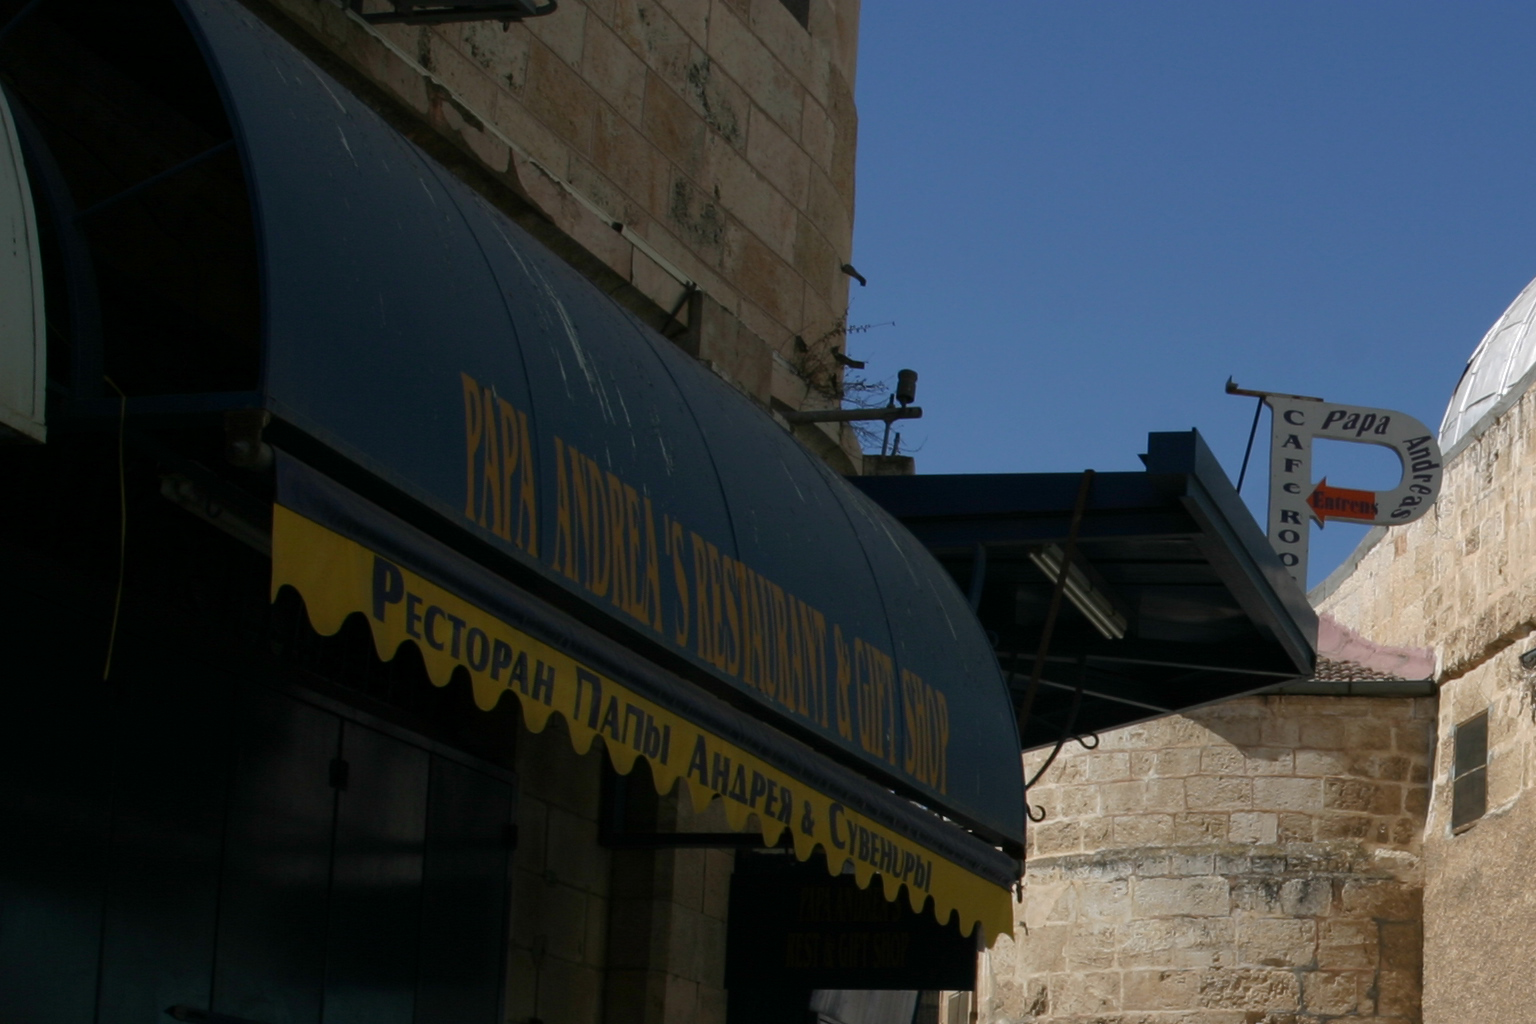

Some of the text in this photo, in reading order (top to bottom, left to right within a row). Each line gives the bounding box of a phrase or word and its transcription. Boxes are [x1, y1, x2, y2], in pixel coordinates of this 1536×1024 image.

[1321, 410, 1390, 437] Papa
[460, 371, 949, 796] PAPA ANDREA'S RESTAURANT & GIFT SHOP
[801, 800, 815, 837] &
[838, 931, 870, 968] GIFT
[873, 931, 910, 968] SHOP
